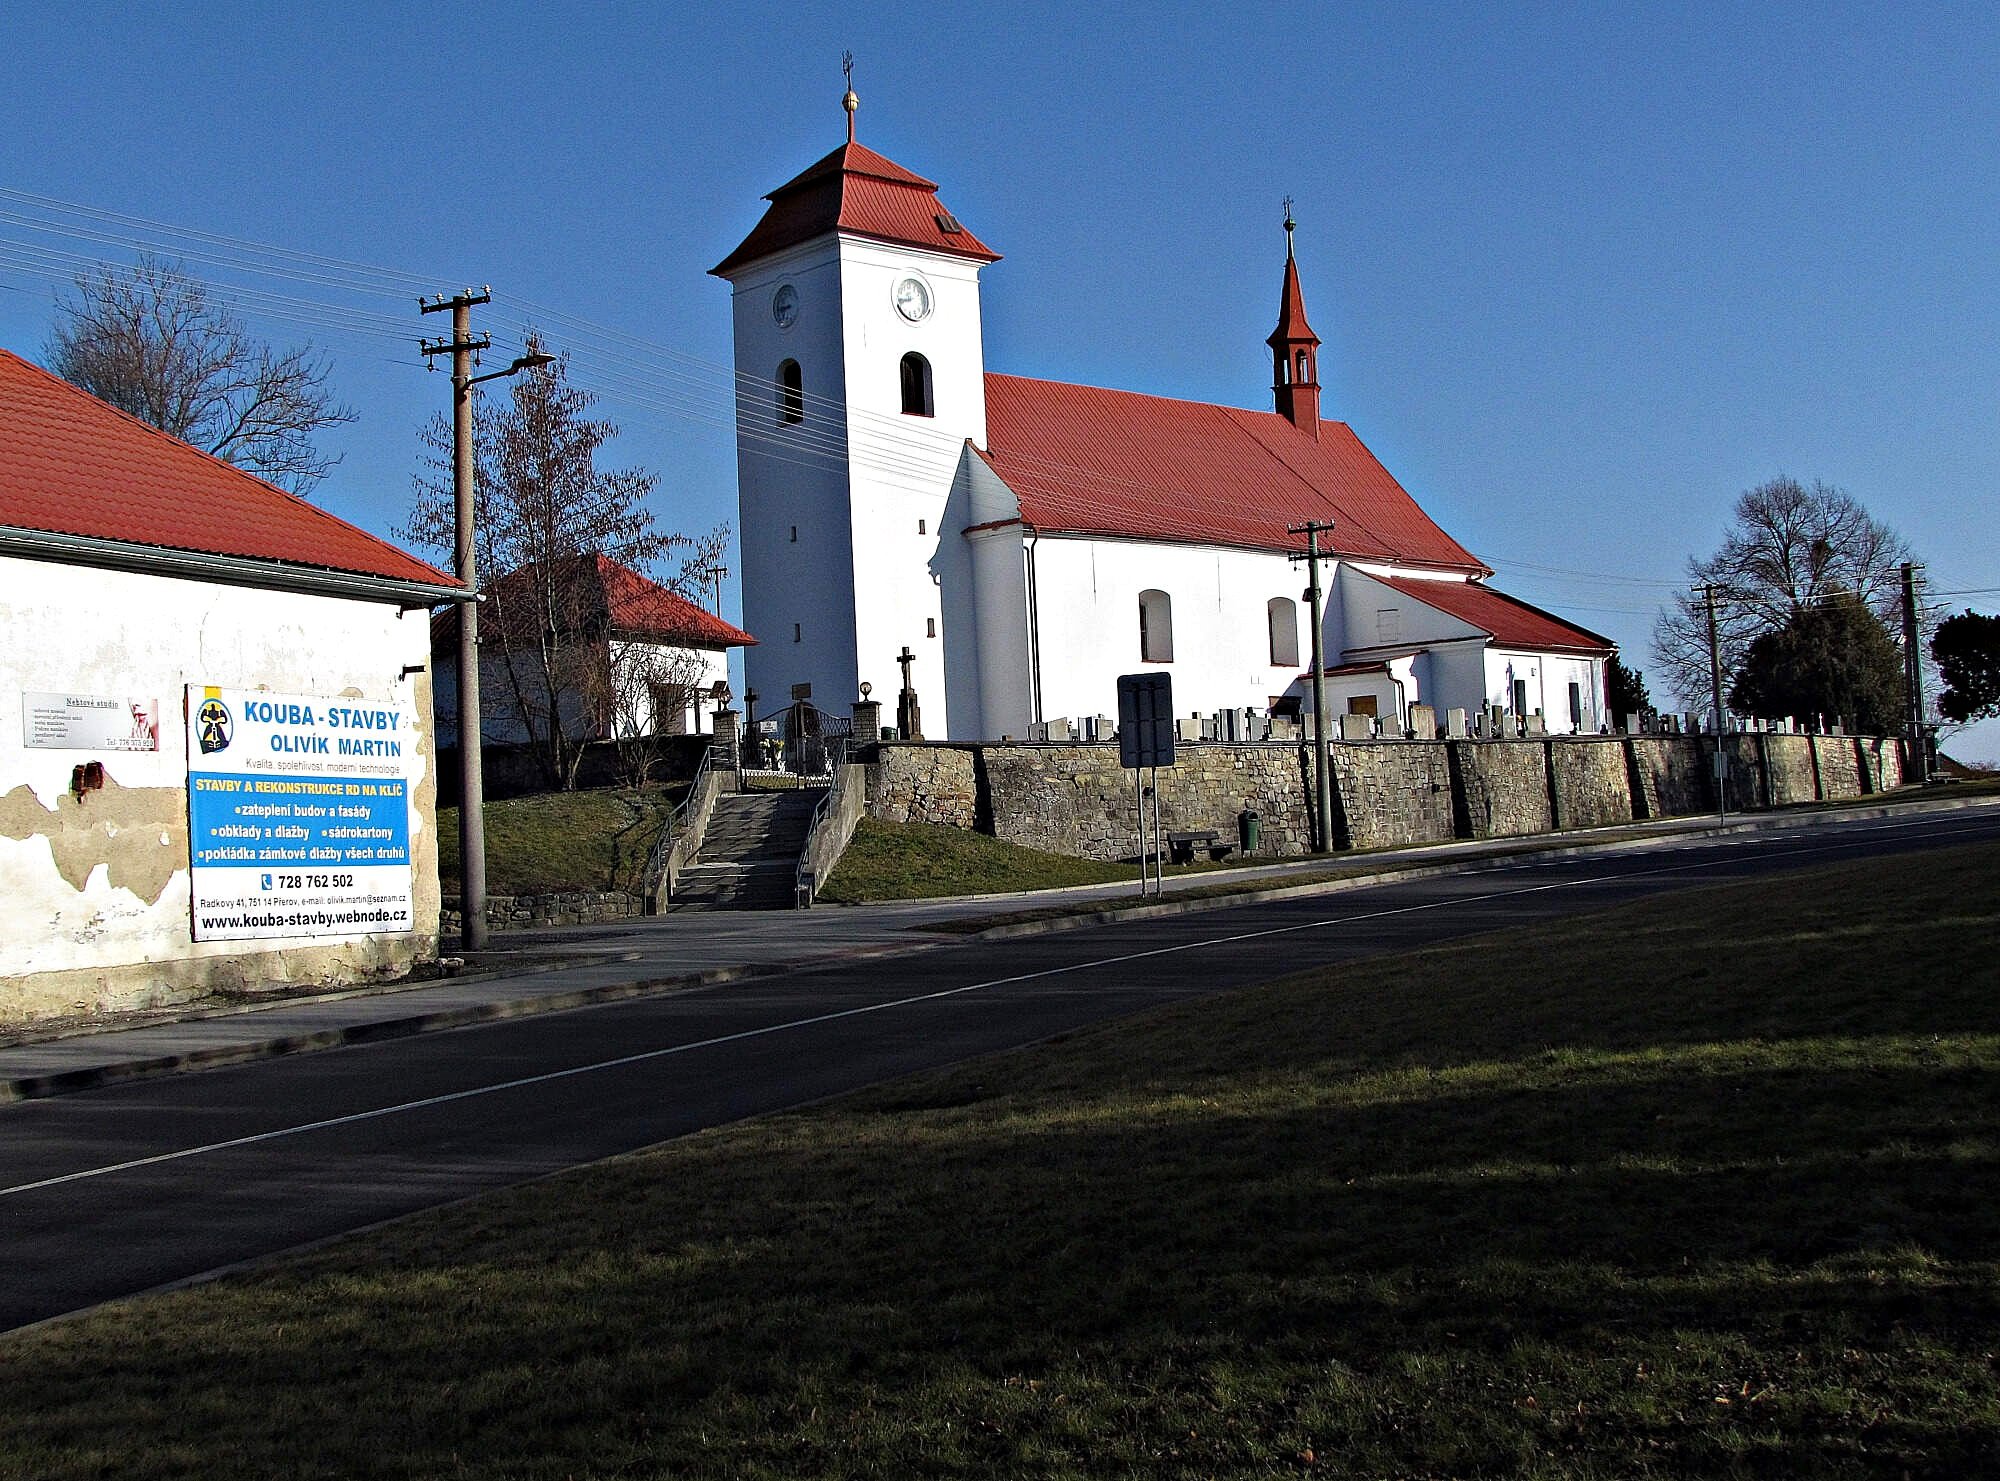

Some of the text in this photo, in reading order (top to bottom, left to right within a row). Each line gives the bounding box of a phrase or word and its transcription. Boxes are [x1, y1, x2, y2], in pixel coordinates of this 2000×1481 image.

[97, 700, 118, 708] studio
[244, 701, 315, 726] KOUBA
[329, 708, 400, 730] STAVBY
[271, 732, 400, 756] OLIVÍK MARTIN
[359, 765, 400, 775] technologie
[196, 779, 402, 796] STAVBY A REKONSTRUKCE RD NA KLÍČ
[242, 804, 371, 820] zateplení budov a fasády
[219, 825, 393, 840] obklady a dlažby sádrokartony
[205, 847, 404, 862] pokládka zámkové dlažby všech druhů
[278, 874, 353, 889] 728 762 502
[200, 899, 235, 910] Radkovy
[236, 898, 247, 909] 41,
[249, 898, 261, 907] 751
[263, 898, 272, 907] 14
[273, 896, 300, 907] Přerov,
[302, 896, 326, 906] e-mail:
[202, 909, 407, 929] www.kouba-stavby.webnode.cz
